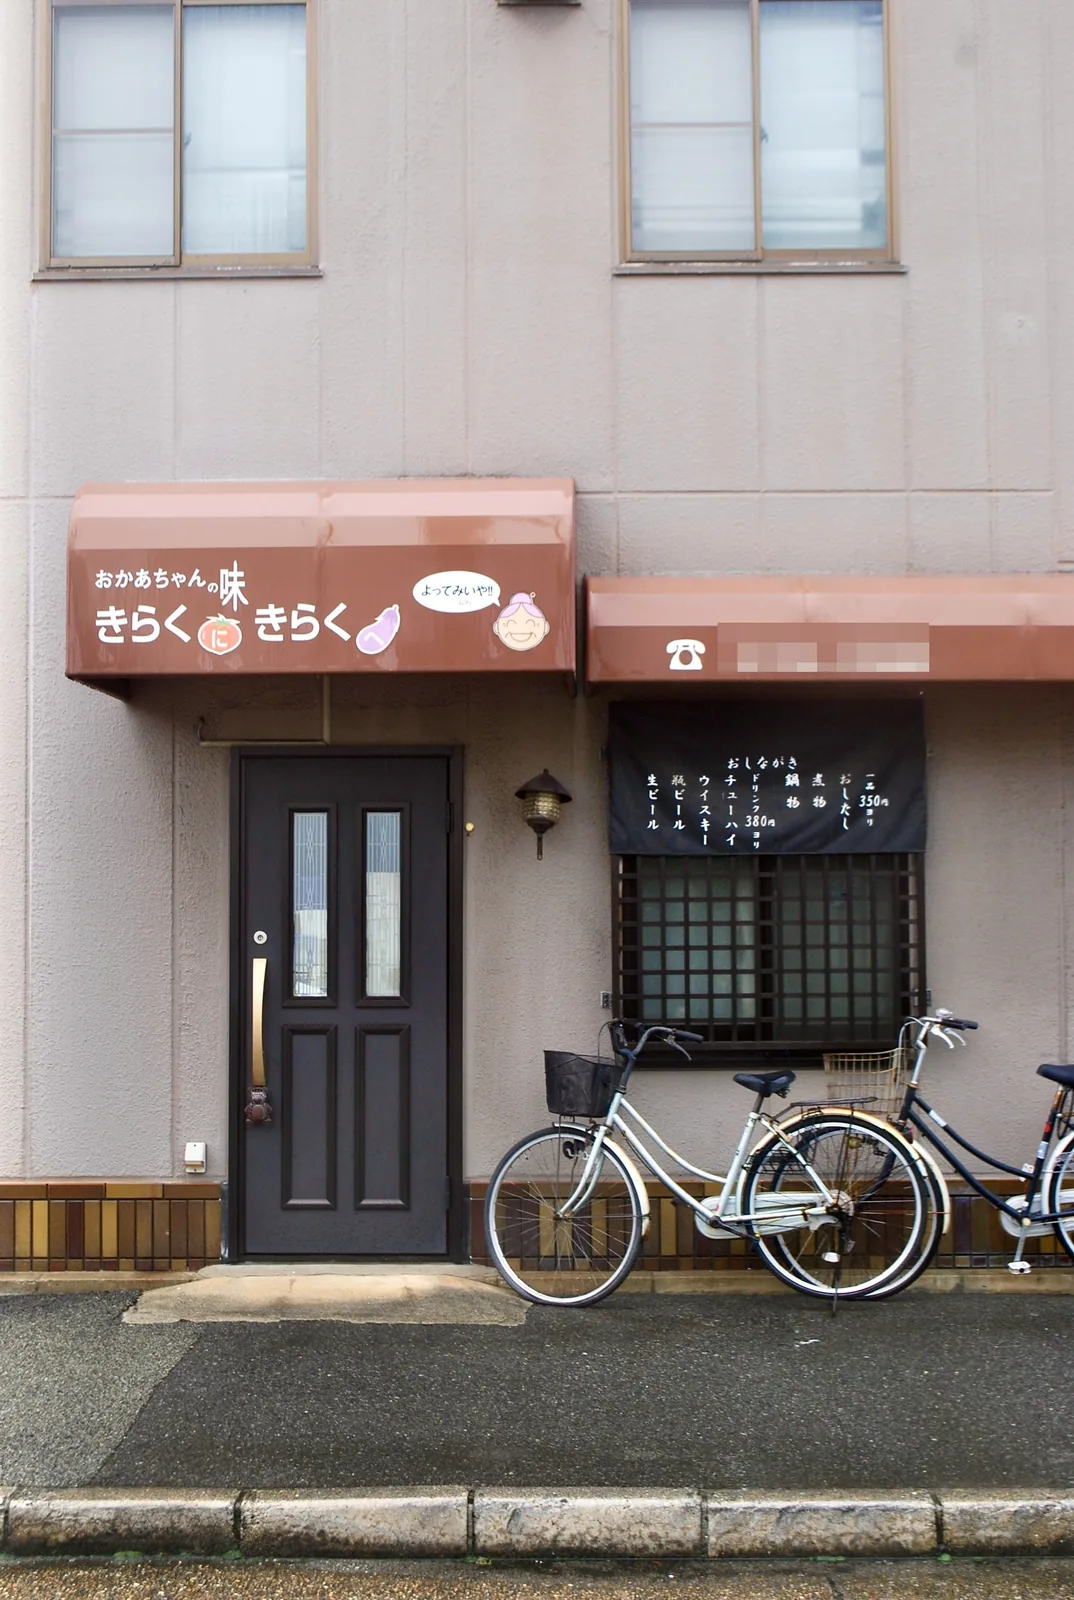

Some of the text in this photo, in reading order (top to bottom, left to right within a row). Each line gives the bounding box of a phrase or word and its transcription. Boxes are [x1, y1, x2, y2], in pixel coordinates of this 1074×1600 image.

[95, 560, 249, 612] おかあちゃんの味
[727, 755, 798, 770] おしながき
[647, 773, 660, 830] 生ビール
[671, 773, 687, 830] 瓶ビール
[699, 775, 711, 846] ウイスキー
[724, 774, 738, 846] チューハイ
[784, 773, 801, 809] 鍋物
[811, 773, 827, 808] 煮物
